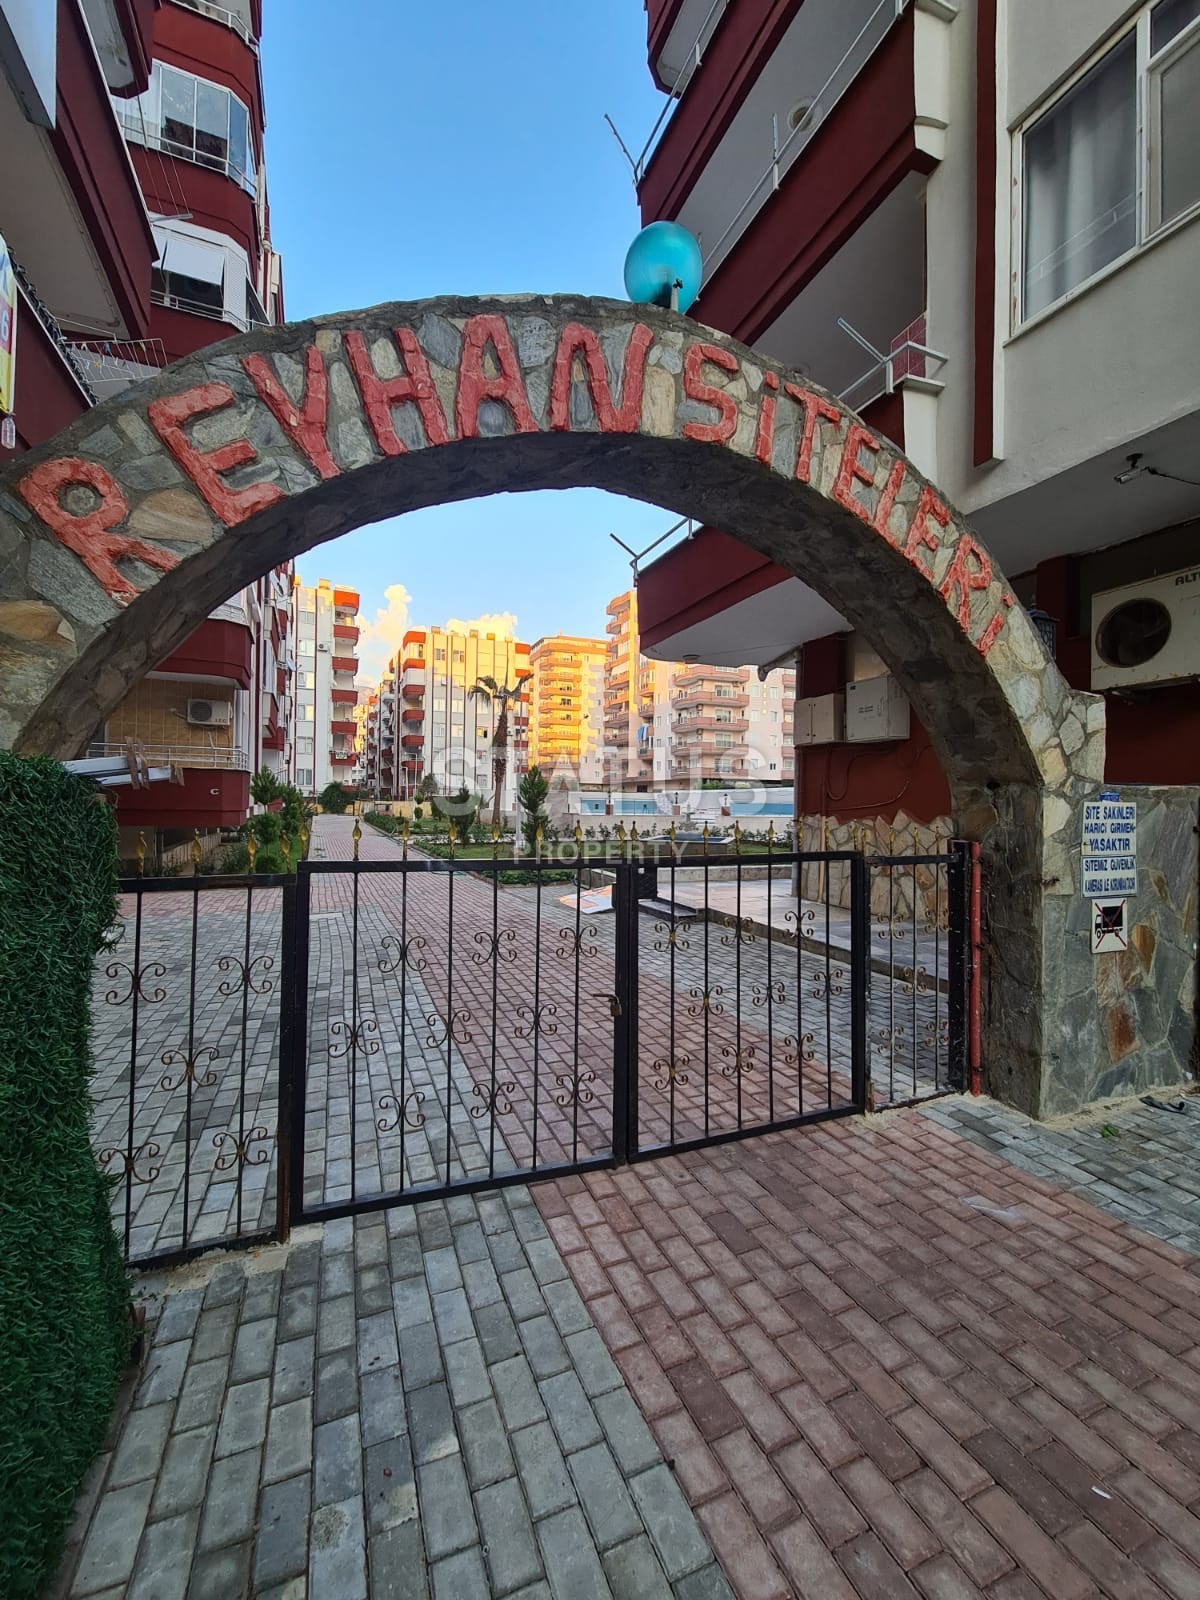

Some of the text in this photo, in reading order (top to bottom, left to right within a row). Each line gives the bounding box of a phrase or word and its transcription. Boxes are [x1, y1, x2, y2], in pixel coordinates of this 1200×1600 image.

[17, 314, 654, 608] REYHAN
[1175, 573, 1200, 586] ALT
[1089, 838, 1130, 852] YASAKTIR
